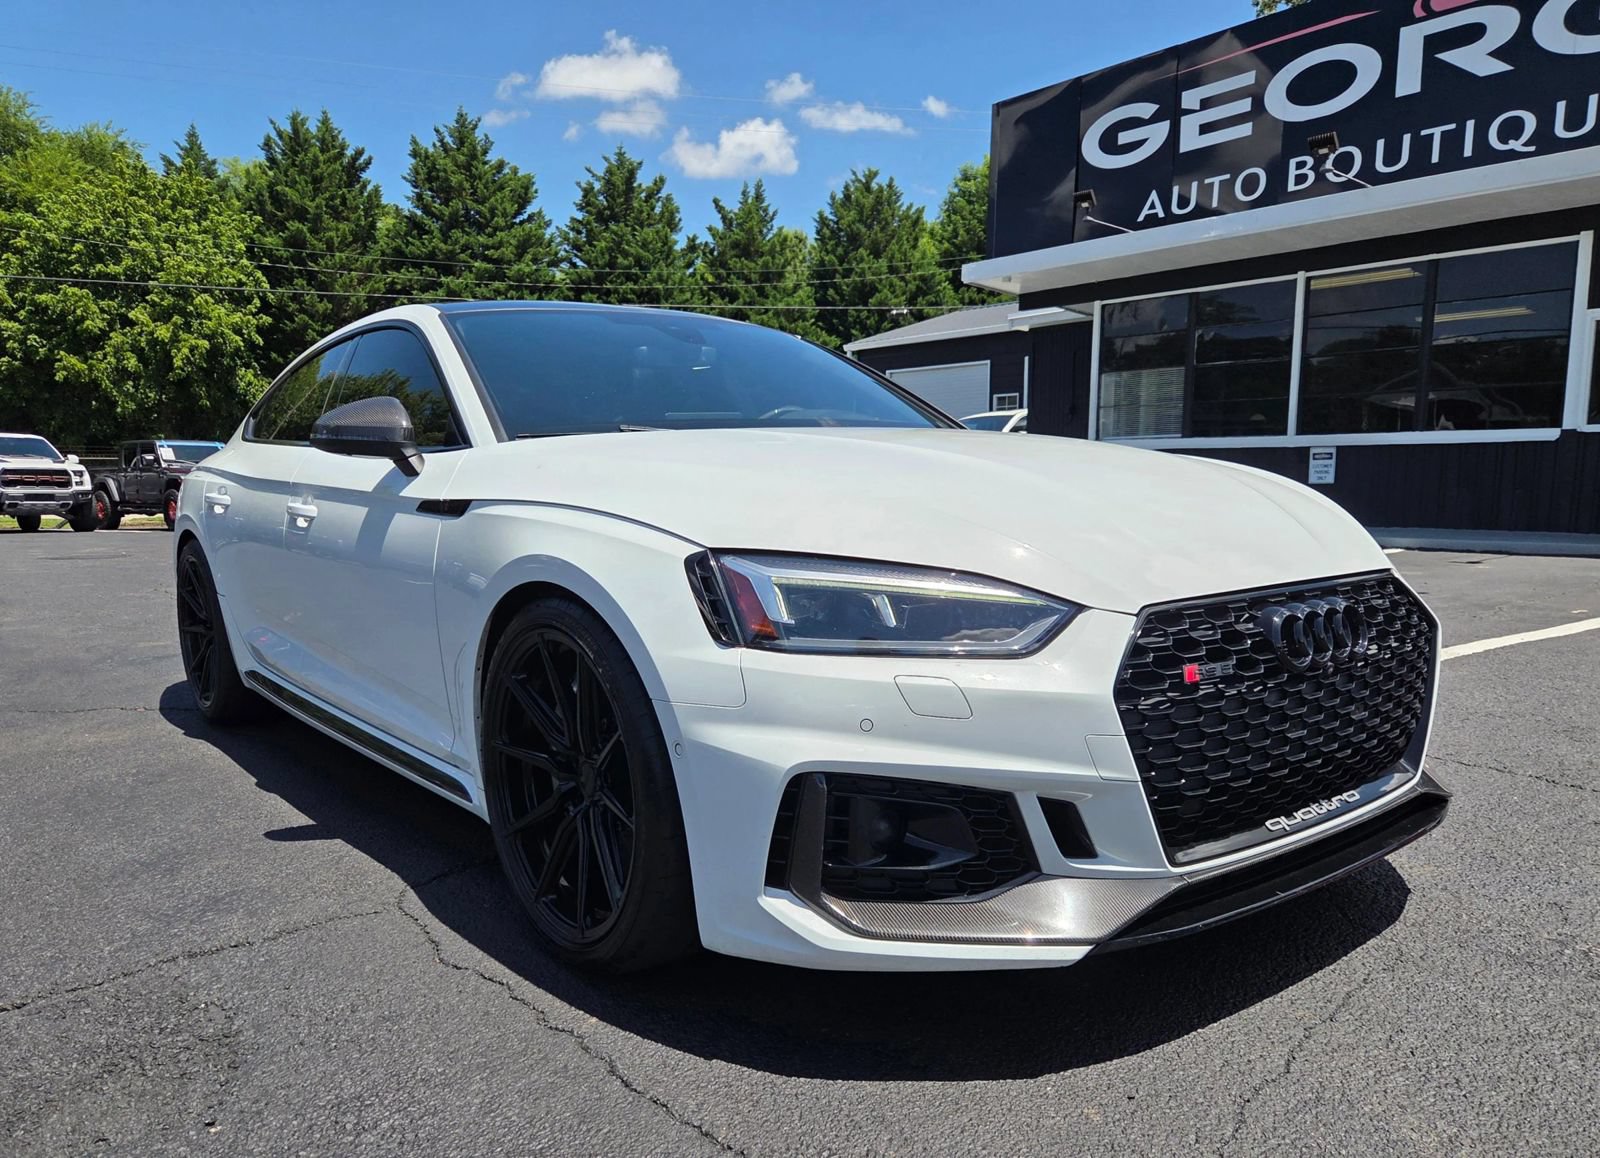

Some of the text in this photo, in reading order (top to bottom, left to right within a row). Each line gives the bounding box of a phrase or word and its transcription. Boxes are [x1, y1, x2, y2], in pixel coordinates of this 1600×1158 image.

[1137, 93, 1600, 222] AUTO BOUTIQU
[1264, 790, 1361, 832] quattro
